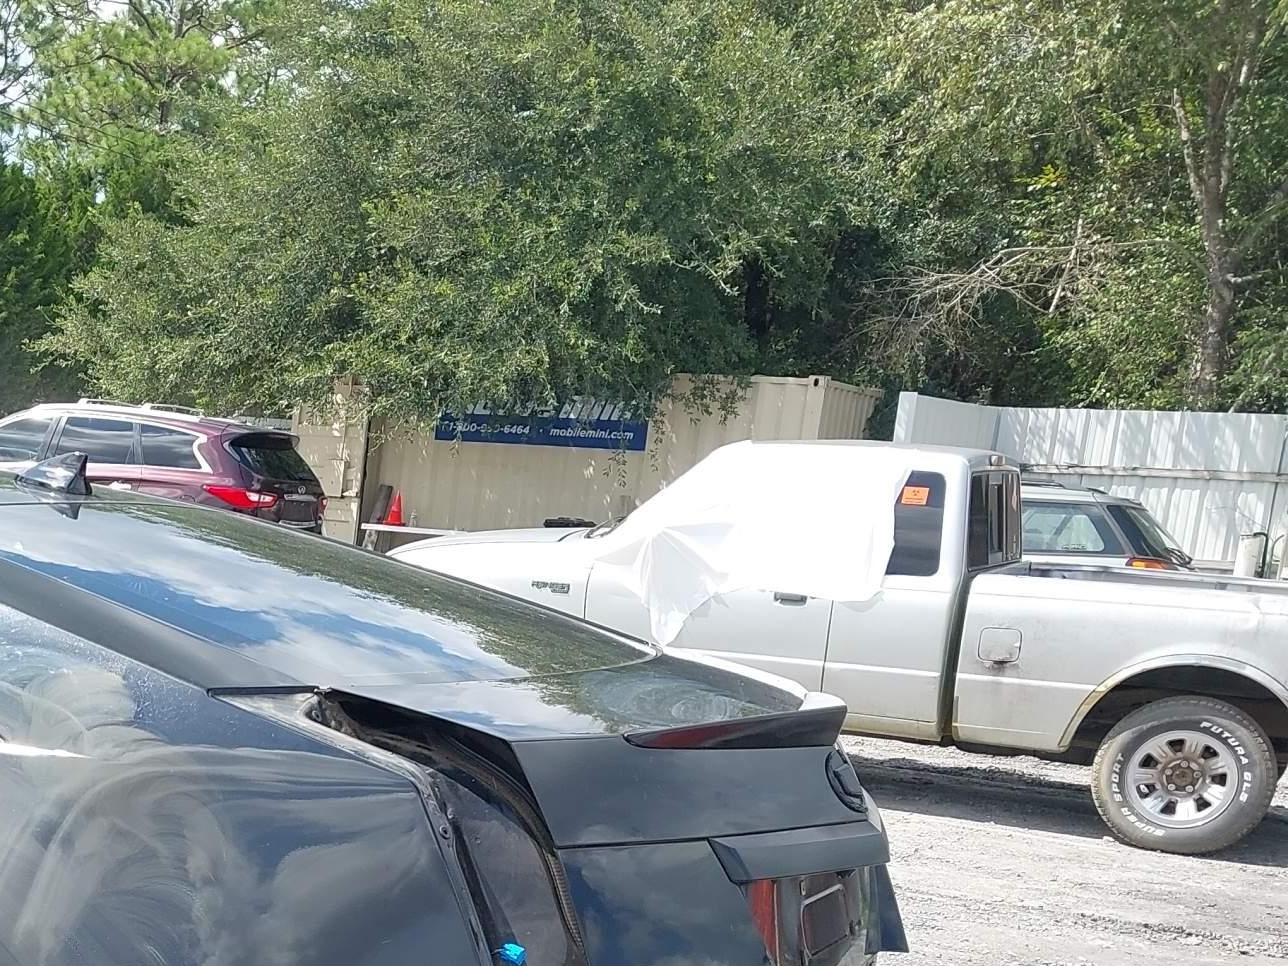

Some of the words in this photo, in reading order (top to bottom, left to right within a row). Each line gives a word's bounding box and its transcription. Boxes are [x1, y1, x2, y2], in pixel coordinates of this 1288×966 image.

[549, 427, 634, 440] mobilemini.com
[1112, 752, 1126, 802] SPORT
[1199, 720, 1250, 766] FUTURA
[1238, 771, 1253, 803] GLS
[1120, 807, 1166, 837] SUPER
